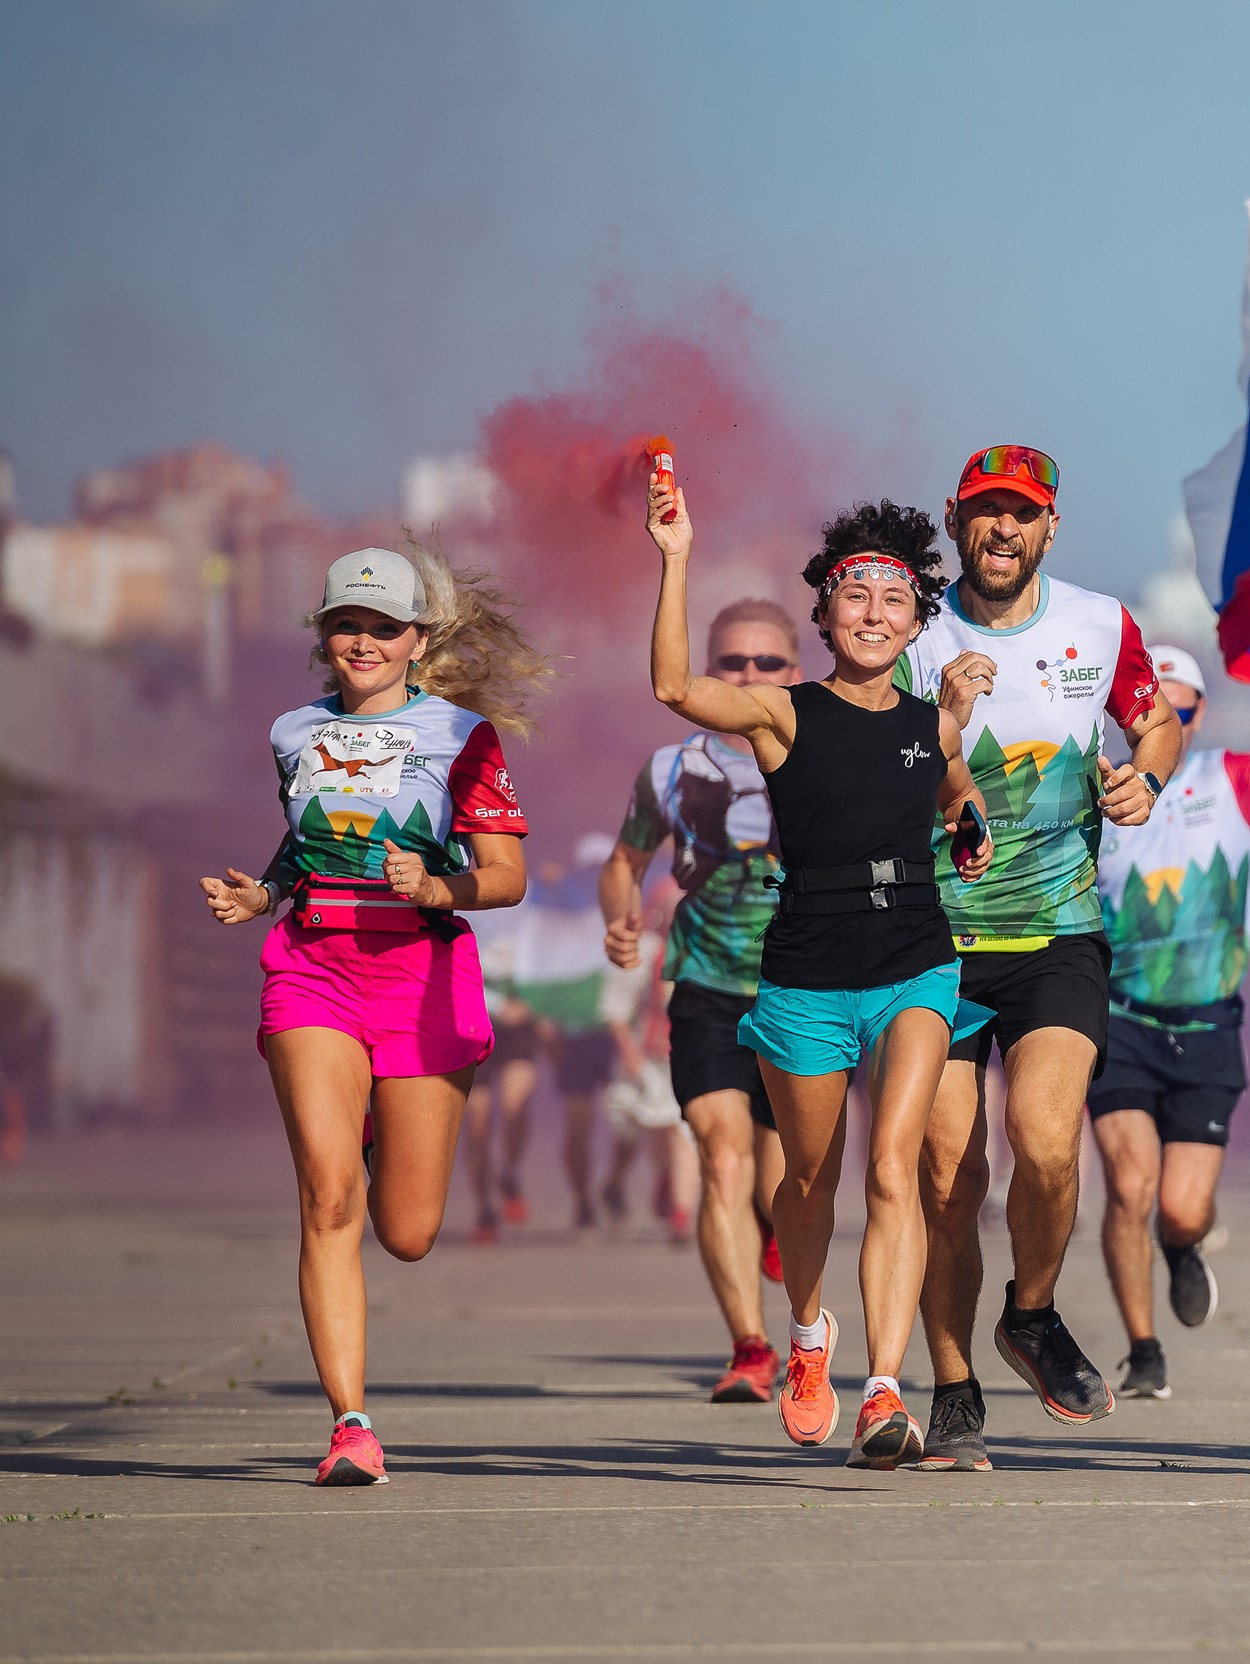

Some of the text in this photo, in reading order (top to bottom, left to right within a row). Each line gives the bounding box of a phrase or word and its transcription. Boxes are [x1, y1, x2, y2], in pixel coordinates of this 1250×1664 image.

[1059, 667, 1102, 682] ЗАБЕГ
[1061, 685, 1093, 694] Уфимское
[1063, 692, 1095, 700] ожерелье
[900, 741, 931, 768] uglow
[1011, 821, 1030, 829] на
[1033, 820, 1059, 831] 450
